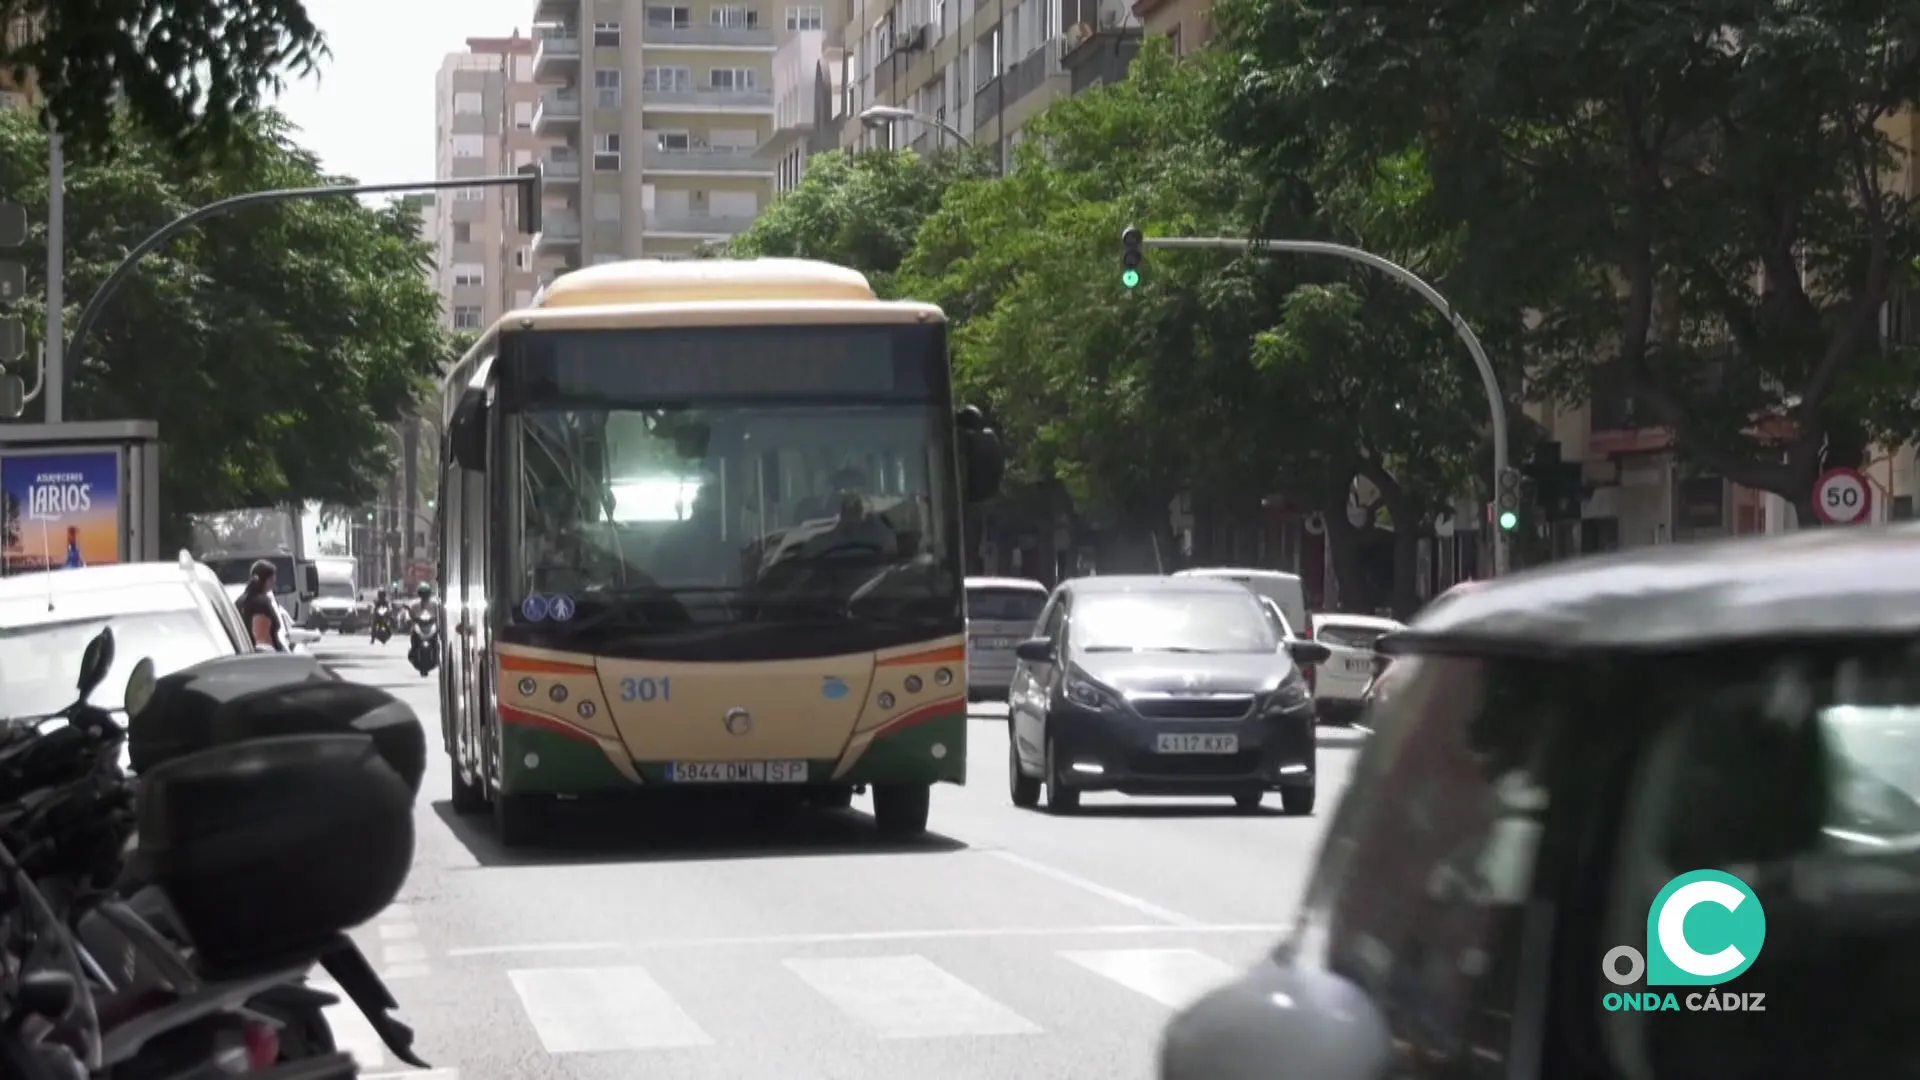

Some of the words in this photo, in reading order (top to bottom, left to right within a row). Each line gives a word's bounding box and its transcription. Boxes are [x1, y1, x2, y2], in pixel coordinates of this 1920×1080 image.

[29, 483, 91, 520] LARIOS
[1827, 487, 1857, 507] 50
[620, 677, 670, 701] 301
[1161, 736, 1200, 750] 4117
[676, 763, 720, 780] 5844
[772, 762, 803, 780] SP
